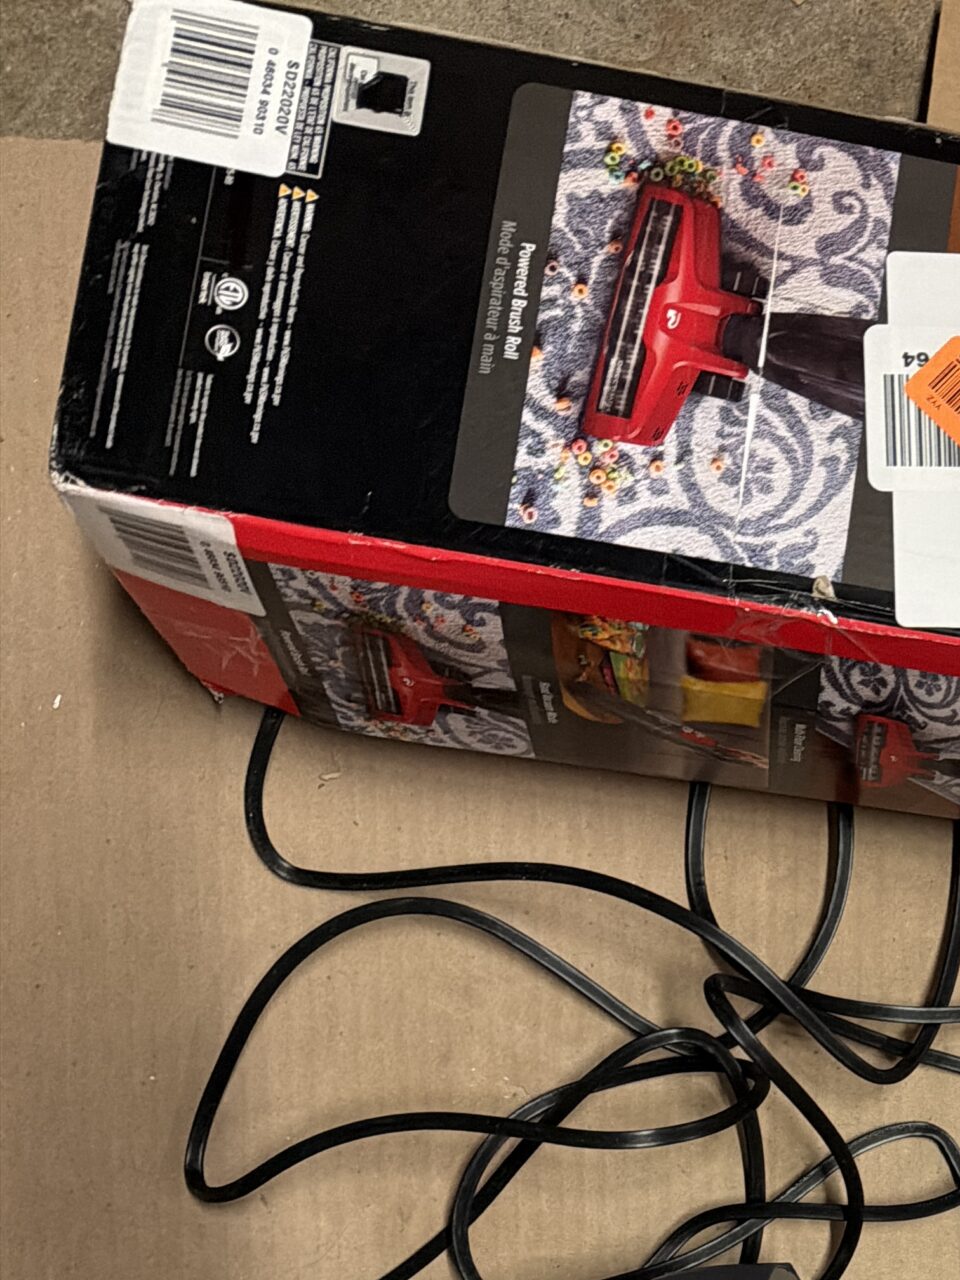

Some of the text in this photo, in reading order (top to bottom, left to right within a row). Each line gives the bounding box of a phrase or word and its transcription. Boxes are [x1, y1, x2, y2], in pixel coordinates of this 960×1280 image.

[252, 98, 269, 135] 90310
[274, 59, 299, 135] SD22020V
[477, 219, 517, 375] Mode d'aspirateur à main
[502, 241, 536, 360] Powered Brush Roll
[925, 393, 943, 411] YYZ
